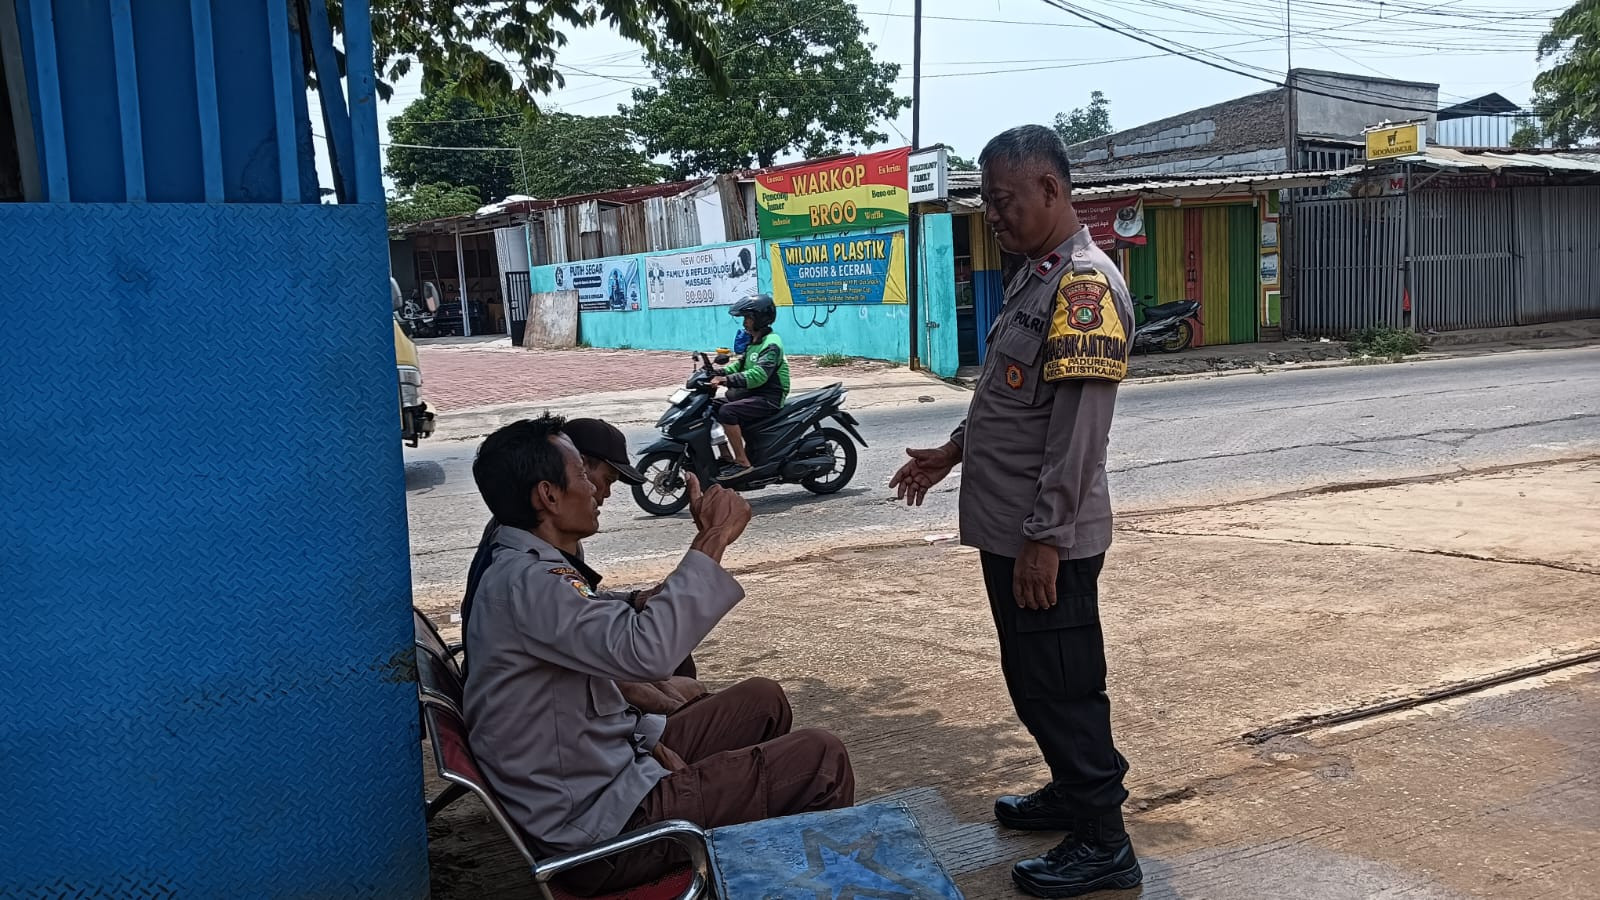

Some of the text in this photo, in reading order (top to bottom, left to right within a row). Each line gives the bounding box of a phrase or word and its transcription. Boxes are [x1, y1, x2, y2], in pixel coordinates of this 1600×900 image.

[792, 164, 866, 197] WARKOP
[809, 200, 857, 227] BROO
[785, 239, 885, 265] MILONA PLASTIK
[681, 254, 713, 265] NEW OPEN
[586, 264, 603, 275] SEGAR
[666, 269, 684, 278] FAMILY
[686, 269, 689, 277] &
[799, 263, 872, 278] GROSIR & ECERAN
[685, 277, 712, 286] MASSAGE
[1014, 311, 1045, 333] POLRI
[1068, 358, 1121, 370] PADURENAN
